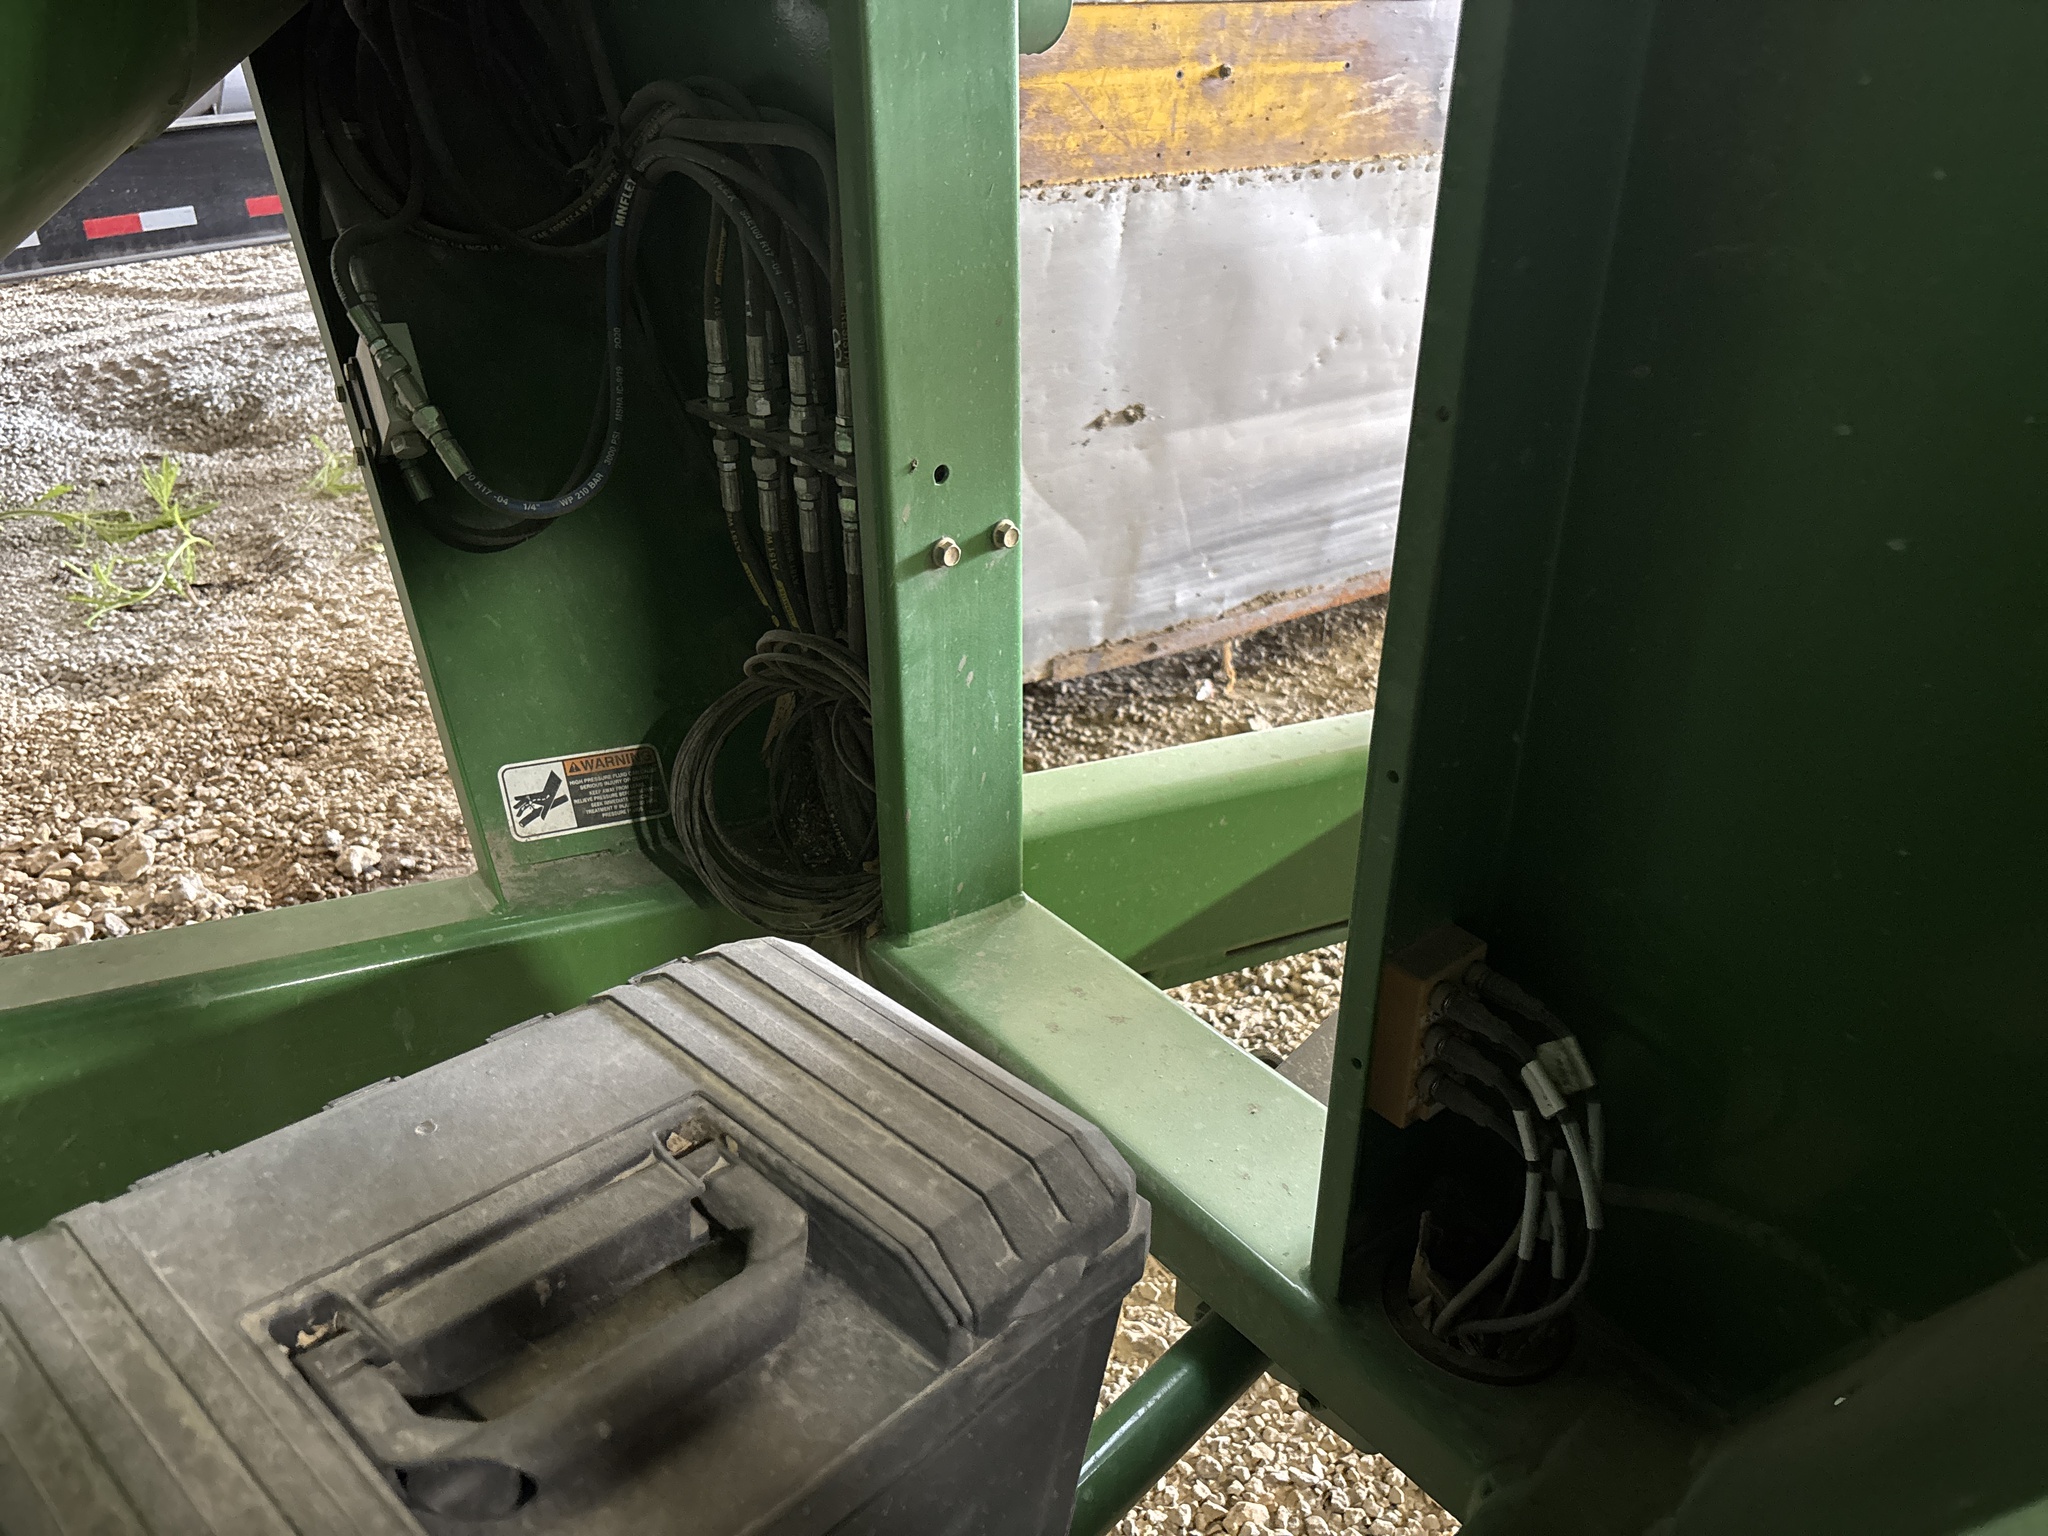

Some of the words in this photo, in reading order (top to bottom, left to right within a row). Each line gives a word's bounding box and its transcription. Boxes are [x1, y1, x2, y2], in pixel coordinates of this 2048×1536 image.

[614, 396, 624, 421] MSHA
[611, 431, 621, 446] PSI
[604, 446, 616, 466] 3000
[587, 472, 604, 490] BAR
[474, 480, 492, 495] R17
[575, 487, 590, 500] 210
[493, 494, 509, 506] -04
[558, 496, 574, 507] WP
[523, 503, 541, 511] 1/4"
[580, 751, 651, 771] WARNING
[584, 774, 611, 783] PRESSURE
[580, 782, 603, 790] SERIOUS
[586, 806, 613, 814] TREATMENT
[602, 810, 626, 818] PRESSURE
